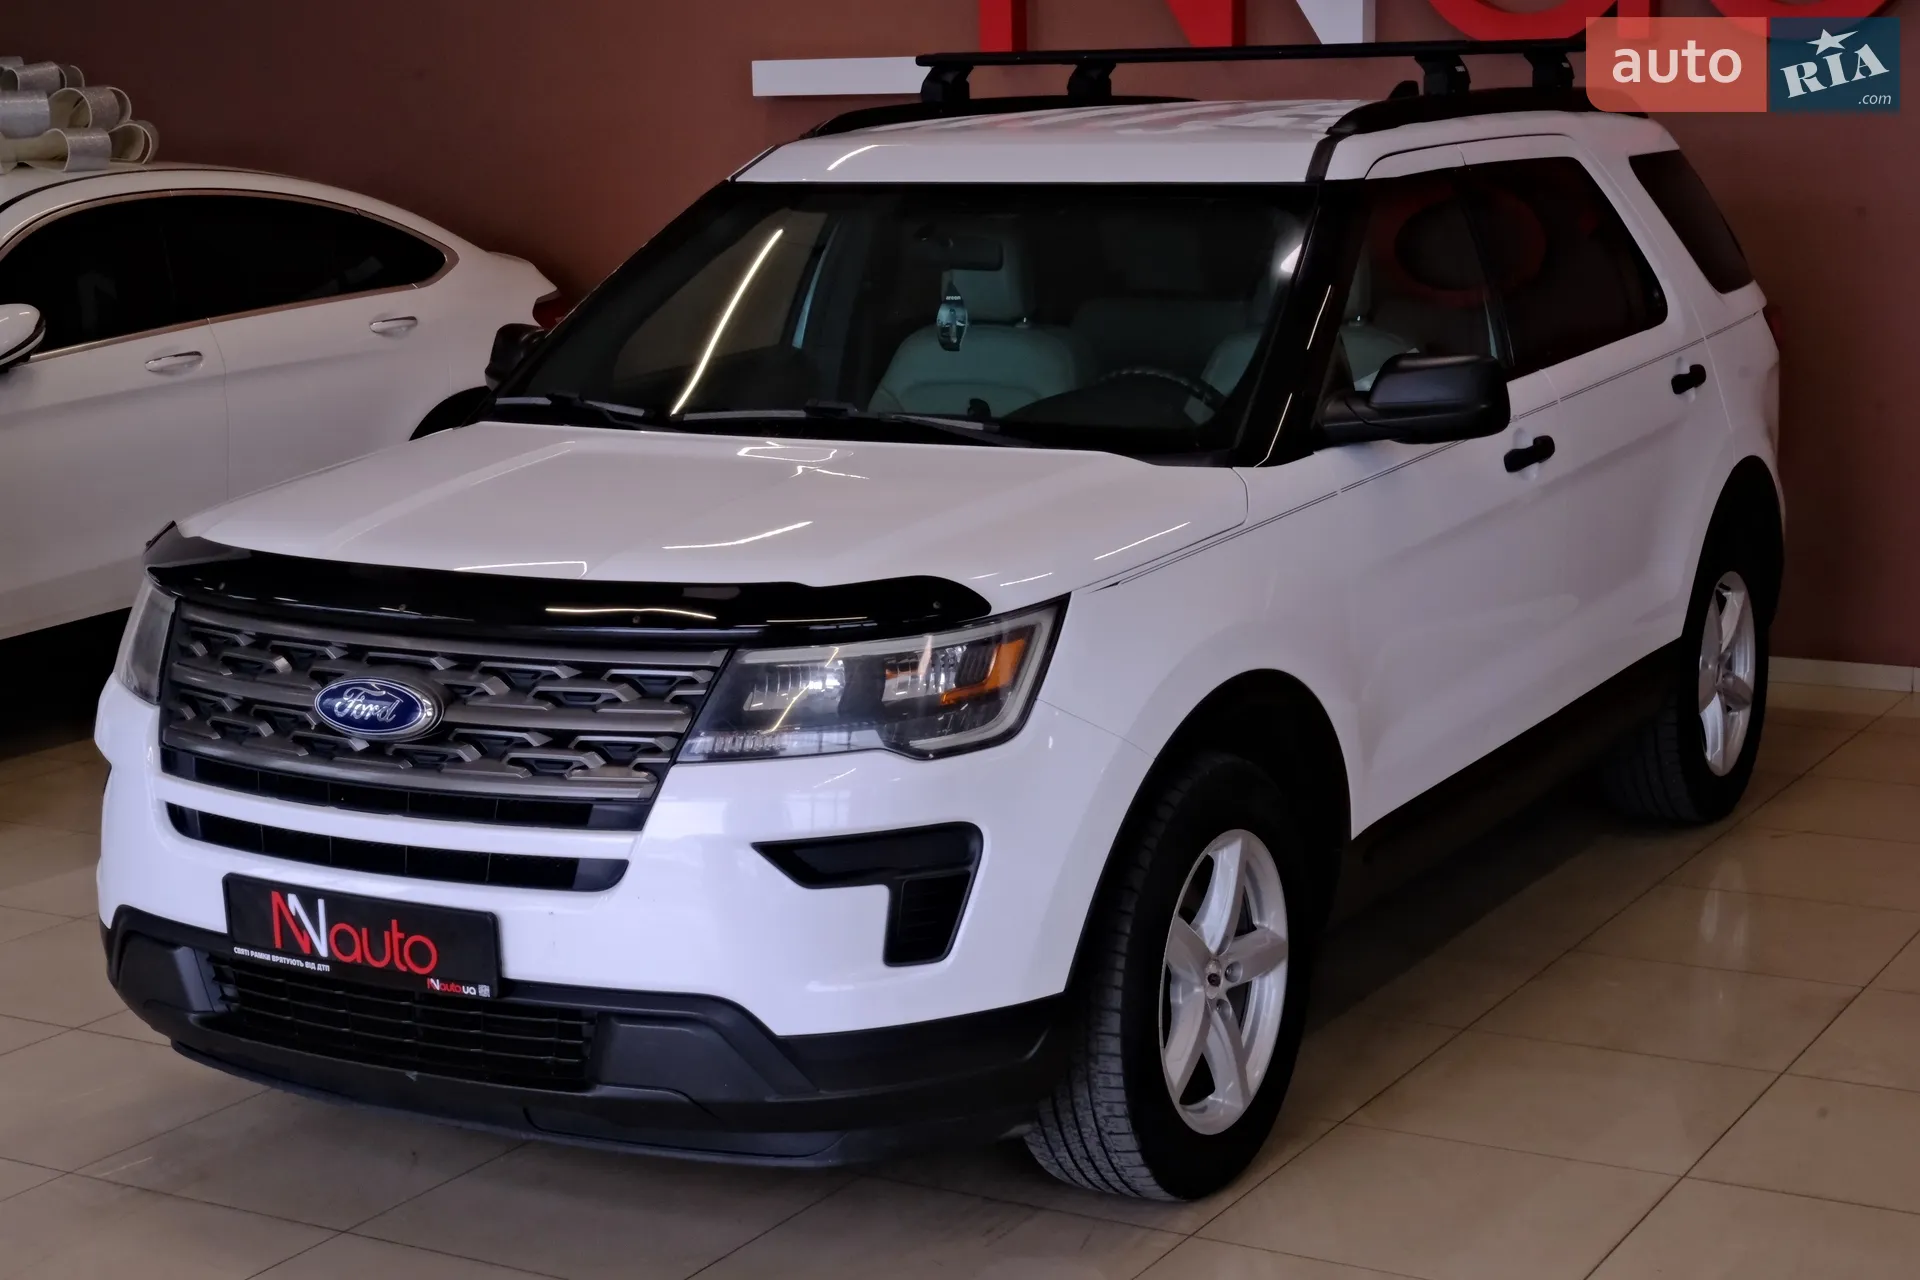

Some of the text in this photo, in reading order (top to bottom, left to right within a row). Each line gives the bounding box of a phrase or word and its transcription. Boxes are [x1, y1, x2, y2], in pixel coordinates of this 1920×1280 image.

[333, 686, 404, 722] Ford
[250, 950, 271, 961] РАМКИ
[271, 954, 304, 968] ВРЯТУЮТЬ
[317, 963, 330, 972] ДТП
